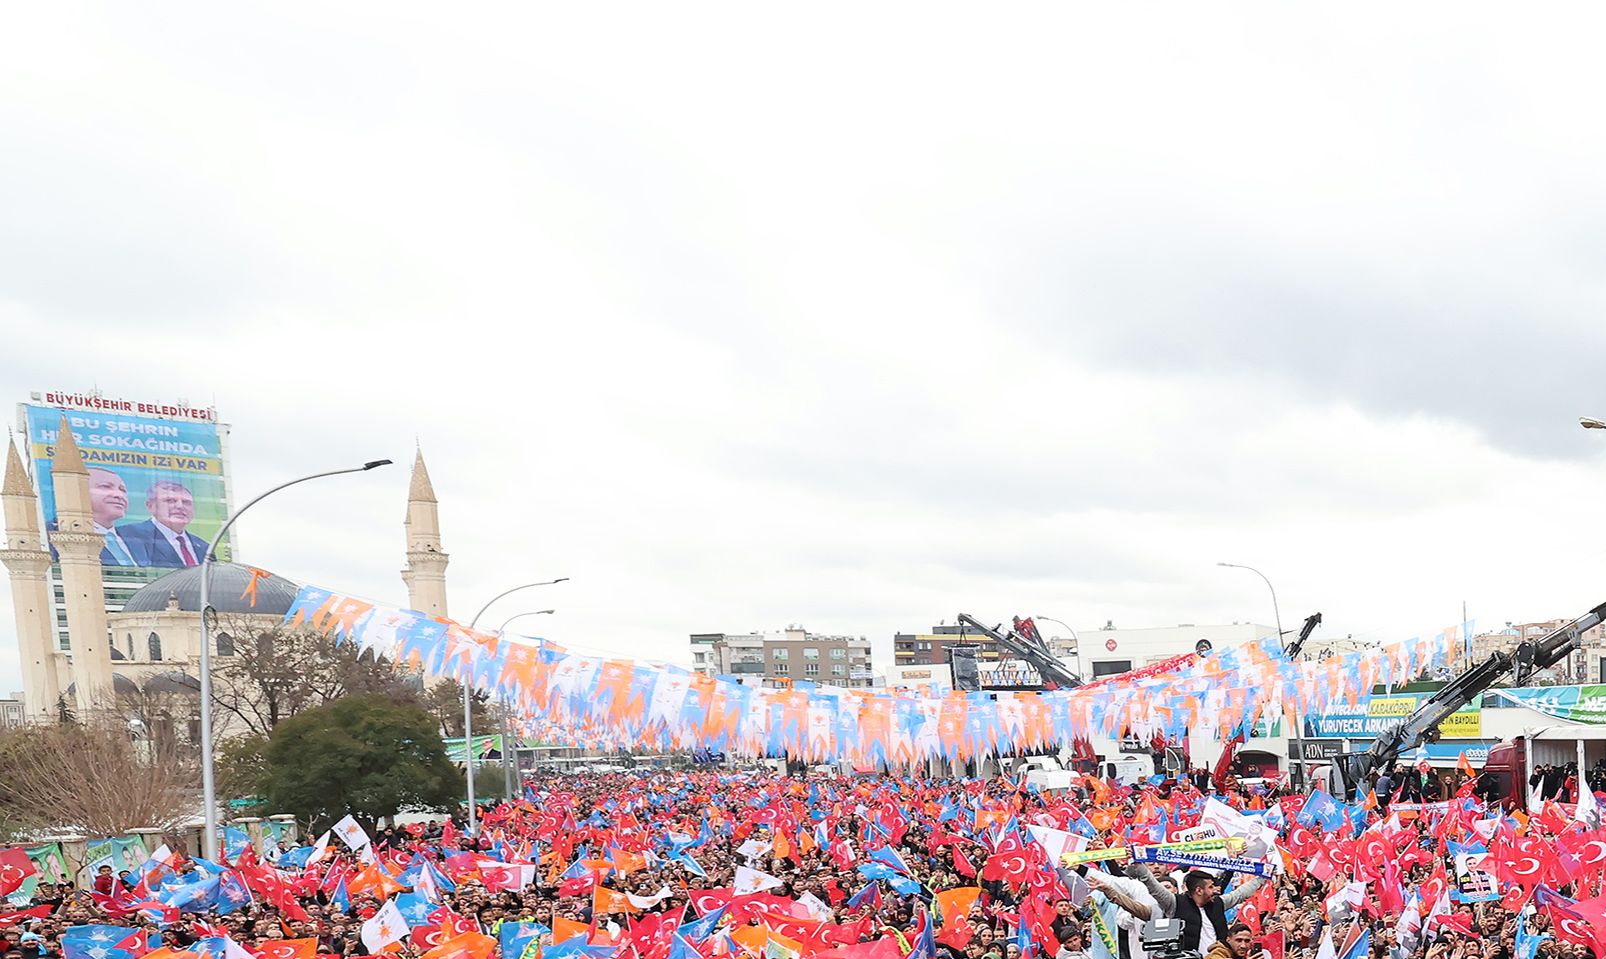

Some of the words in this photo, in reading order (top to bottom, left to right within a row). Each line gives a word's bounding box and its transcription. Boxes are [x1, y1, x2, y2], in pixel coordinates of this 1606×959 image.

[46, 391, 132, 412] BÜYÜKŞEHİR
[71, 416, 100, 429] BU
[41, 429, 84, 444] HR
[46, 446, 147, 465] SDAMIZIN
[176, 458, 207, 471] VAR
